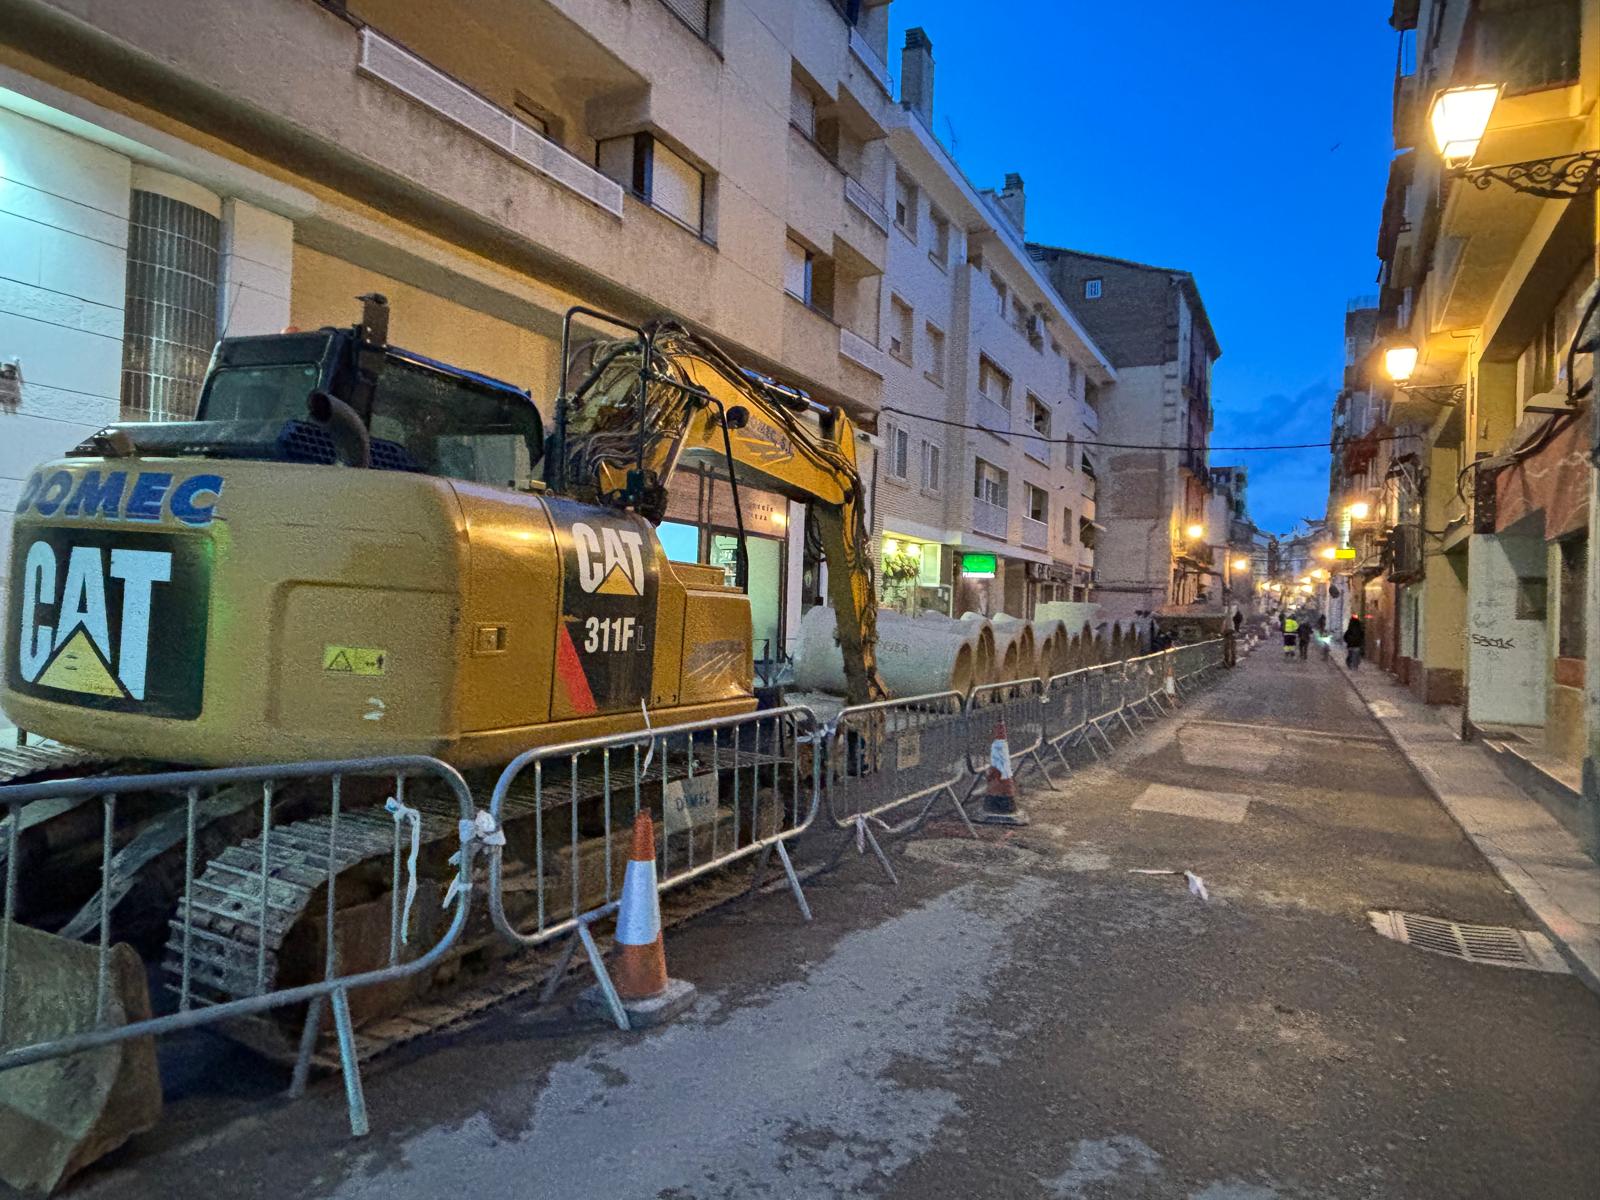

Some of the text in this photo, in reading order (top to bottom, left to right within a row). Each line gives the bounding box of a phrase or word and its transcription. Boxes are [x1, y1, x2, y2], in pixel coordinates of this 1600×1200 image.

[572, 522, 645, 597] CAT
[19, 541, 173, 700] CAT
[584, 616, 635, 653] 311F
